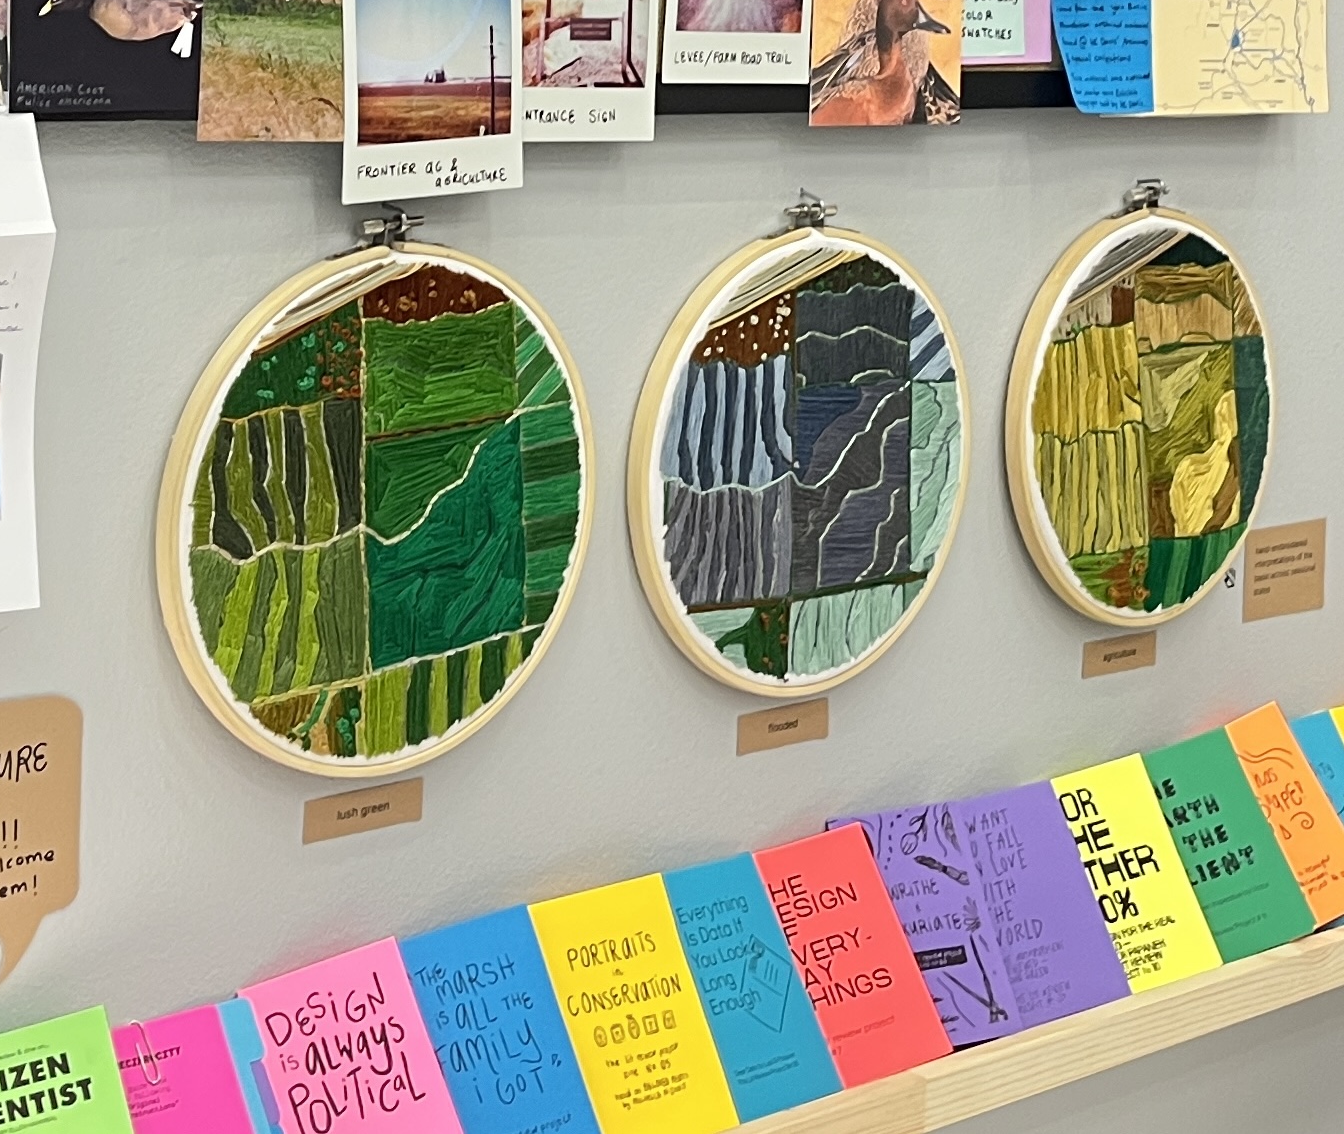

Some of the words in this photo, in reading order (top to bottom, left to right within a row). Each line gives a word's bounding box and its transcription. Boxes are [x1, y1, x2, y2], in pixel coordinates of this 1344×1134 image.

[337, 807, 358, 820] lush
[361, 801, 390, 818] green
[1182, 824, 1229, 853] THE
[676, 894, 749, 925] Everything
[698, 923, 734, 944] Data
[566, 930, 657, 972] PORTRAITS
[690, 951, 717, 970] You
[414, 963, 447, 988] THE
[700, 972, 737, 994] Long
[502, 992, 534, 1011] THE
[567, 973, 683, 1017] CONSERVATION
[709, 987, 762, 1017] Enough
[496, 1066, 545, 1105] GOT
